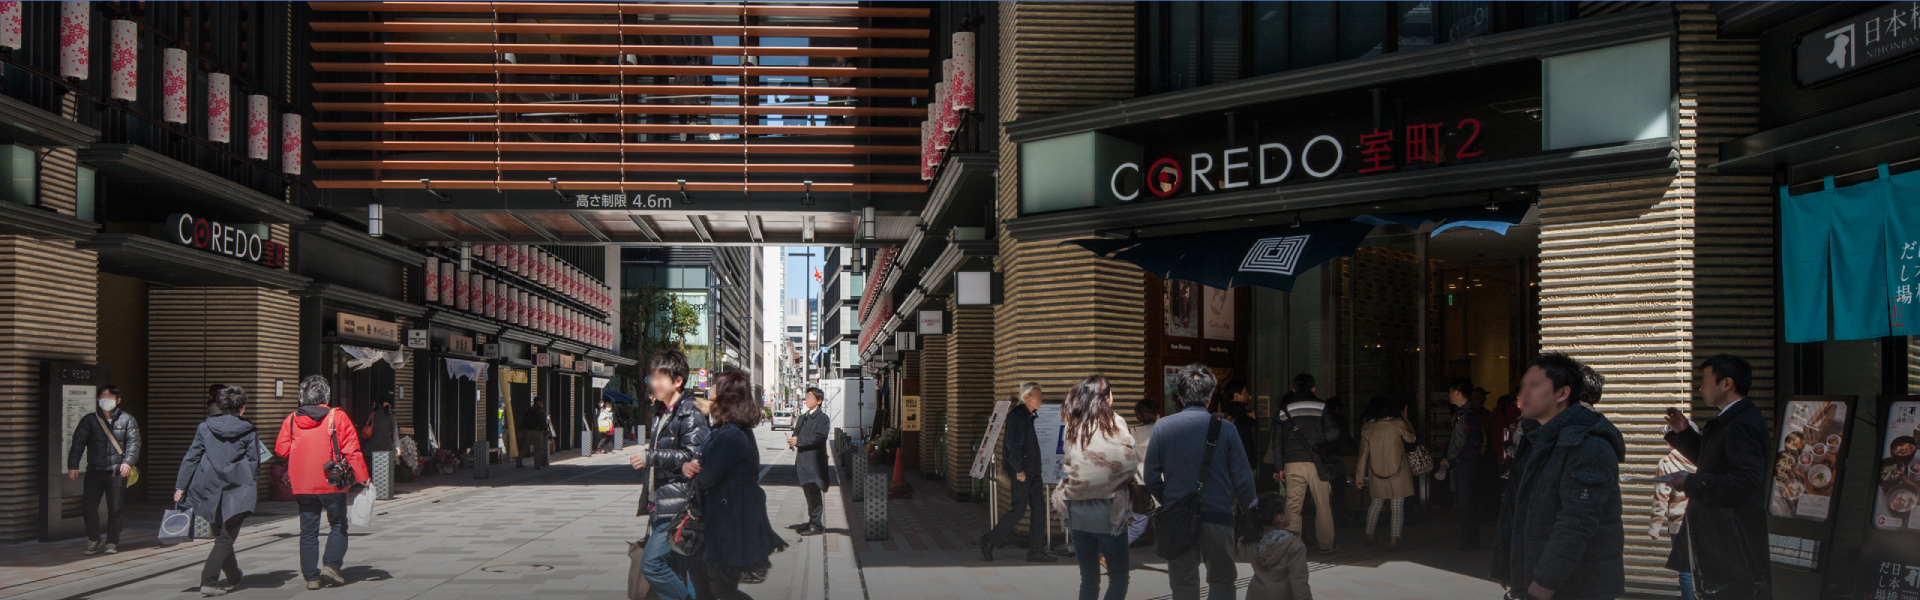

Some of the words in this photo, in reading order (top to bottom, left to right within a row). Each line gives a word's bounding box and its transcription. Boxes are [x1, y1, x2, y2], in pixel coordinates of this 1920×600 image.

[1866, 35, 1920, 59] NIHONBAS
[1111, 134, 1344, 202] COREDO
[576, 194, 627, 208] 高さ制限
[632, 194, 672, 208] 4.6m
[179, 213, 262, 261] COREDO
[1896, 240, 1917, 304] だし場
